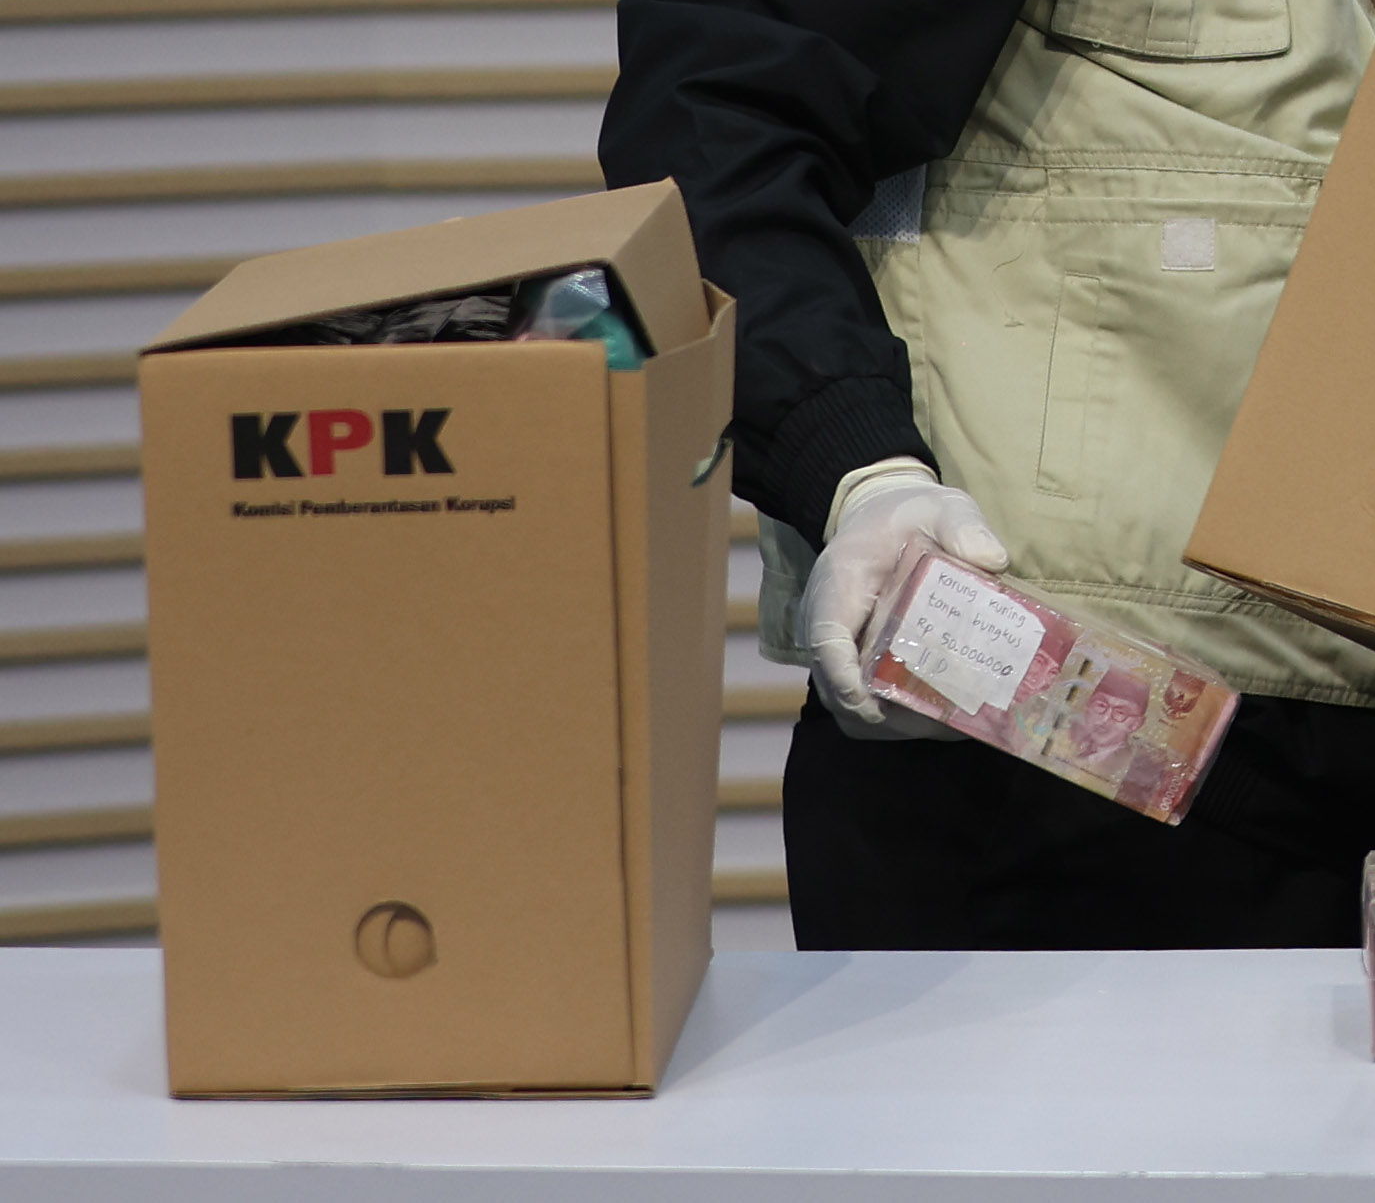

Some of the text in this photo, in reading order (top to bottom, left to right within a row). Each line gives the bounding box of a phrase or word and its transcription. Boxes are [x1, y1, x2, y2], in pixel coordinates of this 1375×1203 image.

[231, 407, 456, 479] KPK
[231, 496, 516, 518] Komisi Pemberantasan Korupsi
[928, 591, 961, 618] tanpa
[916, 617, 934, 637] Rp
